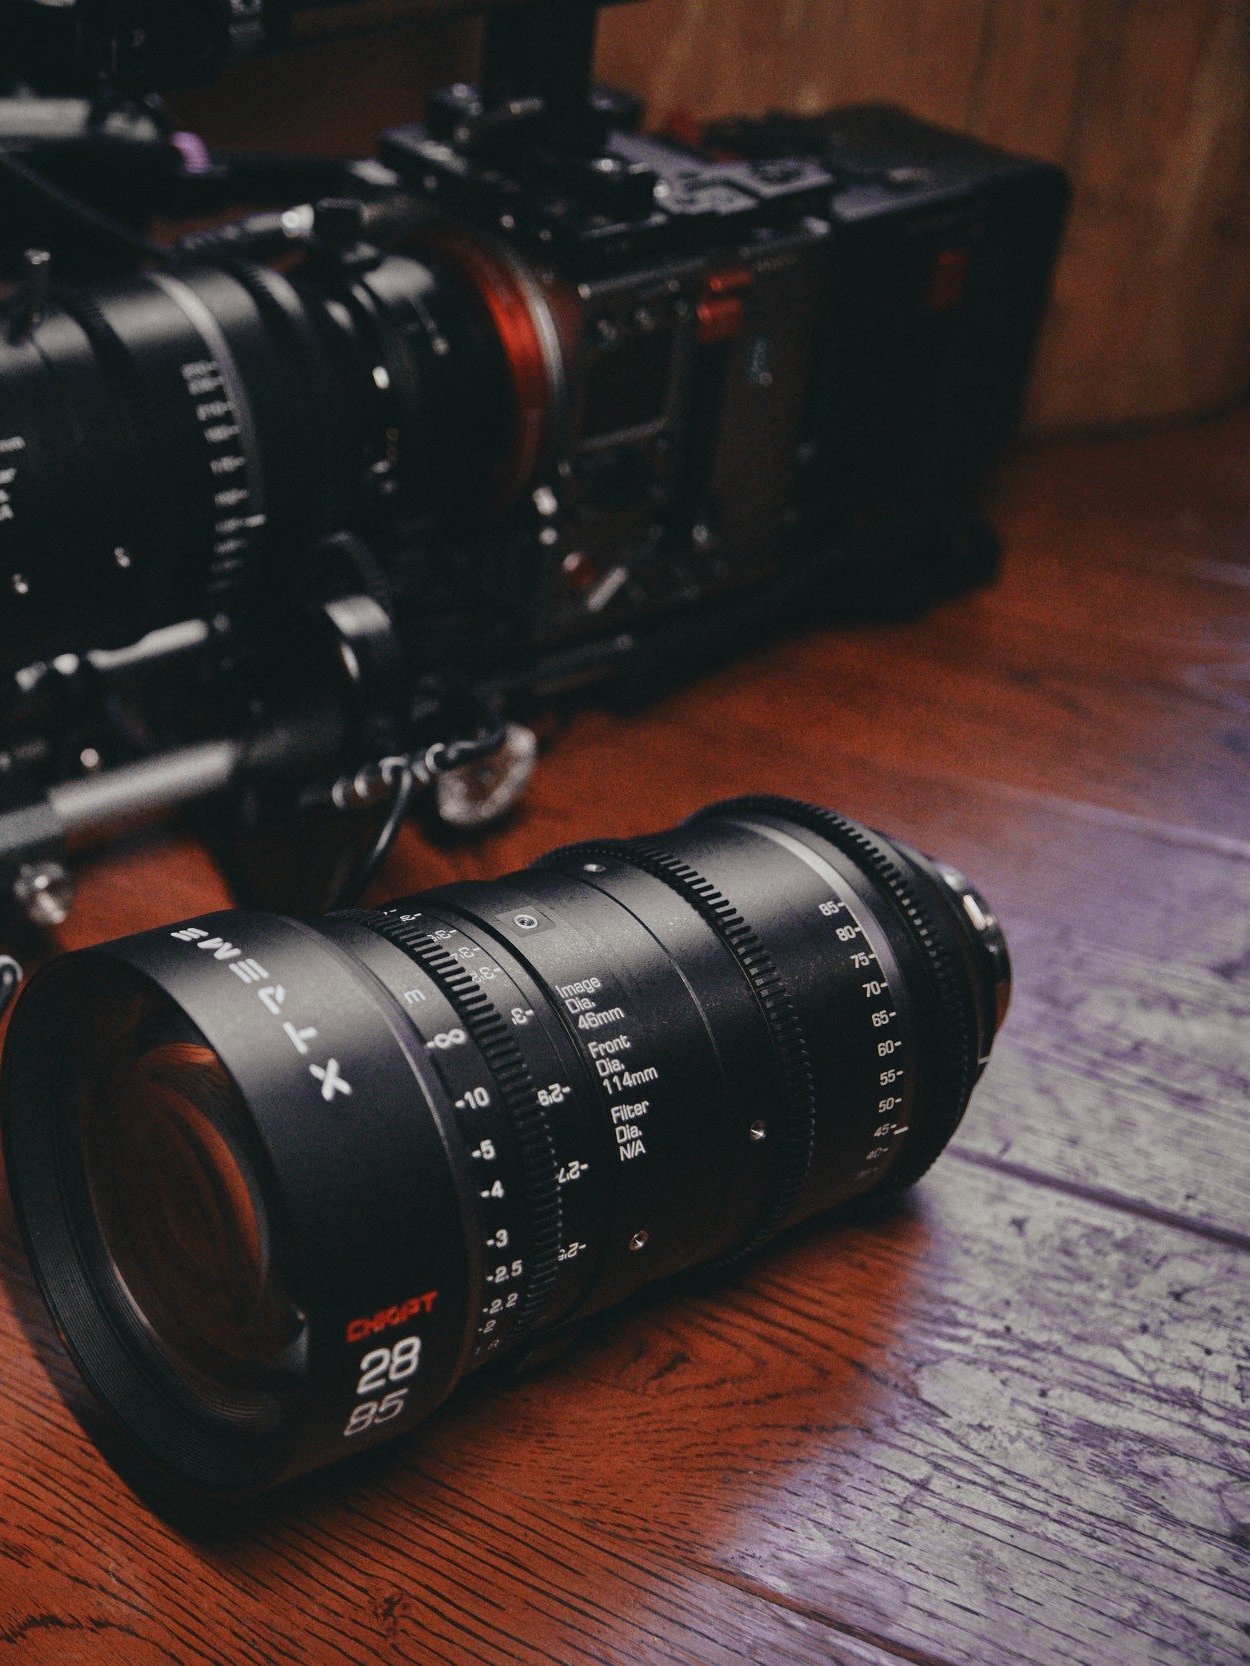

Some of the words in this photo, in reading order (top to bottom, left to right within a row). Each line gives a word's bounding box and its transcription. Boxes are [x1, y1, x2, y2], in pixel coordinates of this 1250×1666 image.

[818, 900, 839, 917] 85
[835, 925, 856, 942] 80
[850, 952, 871, 969] 75
[555, 976, 601, 999] Image
[862, 981, 881, 998] 70
[564, 996, 596, 1015] Dia.
[577, 1006, 625, 1030] 46mm
[871, 1010, 890, 1028] 65
[587, 1034, 631, 1059] Front
[877, 1040, 895, 1057] 60
[595, 1057, 625, 1077] Dia.
[602, 1066, 659, 1095] 114mm
[879, 1069, 896, 1086] 55
[610, 1100, 650, 1124] Filter
[878, 1097, 895, 1113] 50
[615, 1124, 643, 1143] Dia.
[619, 1139, 646, 1161] N/A
[356, 1336, 422, 1395] 28
[344, 1388, 409, 1436] 85
